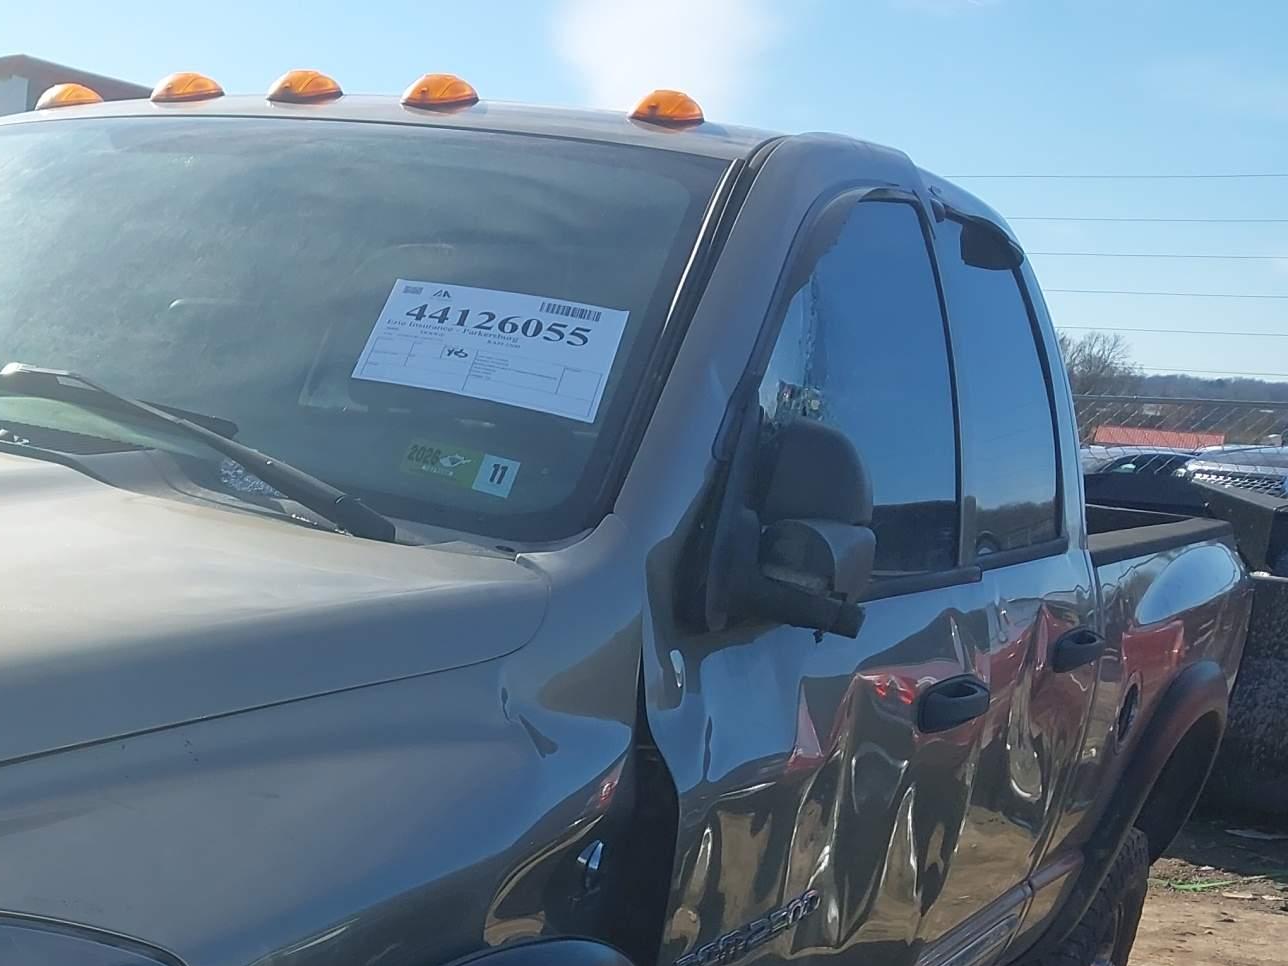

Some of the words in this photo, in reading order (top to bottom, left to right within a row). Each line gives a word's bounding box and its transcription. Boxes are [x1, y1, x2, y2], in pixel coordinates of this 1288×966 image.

[405, 302, 592, 349] 44126055
[408, 444, 442, 466] 2026
[489, 463, 509, 485] 11
